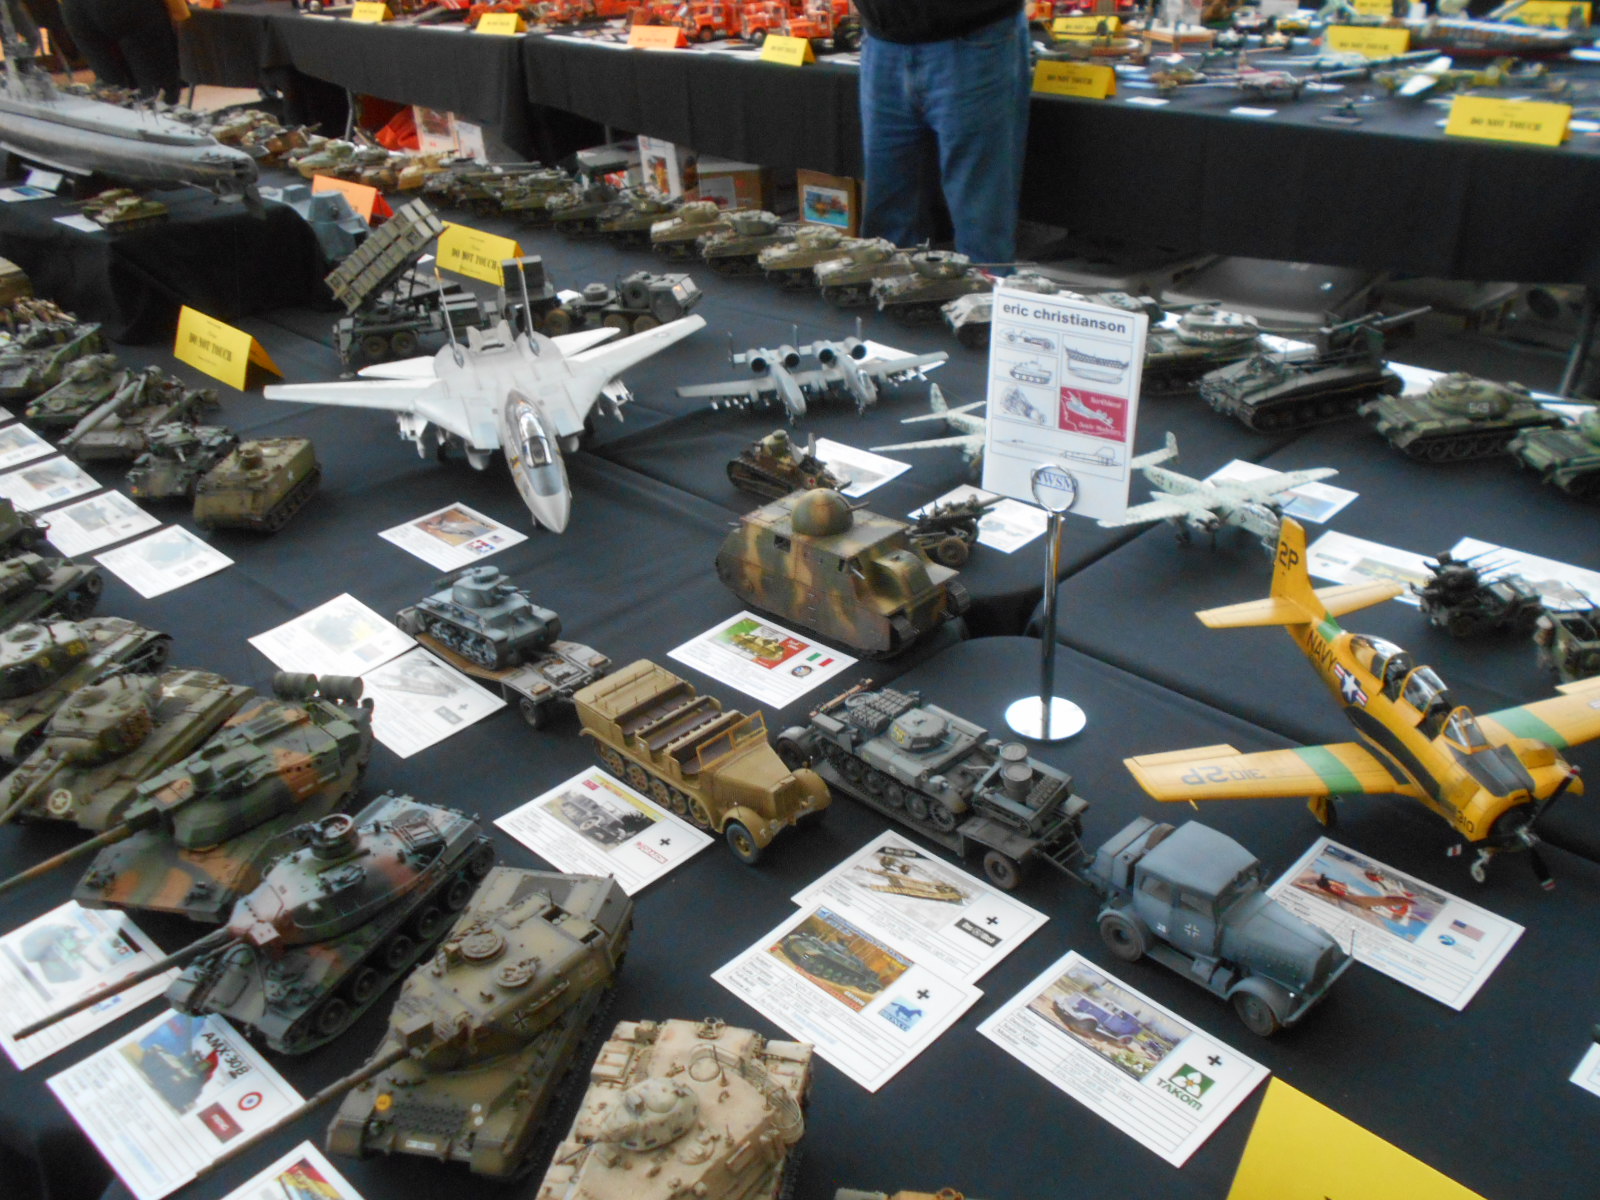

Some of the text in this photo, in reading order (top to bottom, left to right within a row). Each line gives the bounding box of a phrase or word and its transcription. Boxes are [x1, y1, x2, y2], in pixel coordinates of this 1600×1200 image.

[451, 247, 497, 270] DO NOT TOUCH
[1003, 302, 1126, 334] eric christianson
[189, 332, 198, 345] DO
[199, 336, 211, 351] NOT
[211, 342, 233, 362] TOUCH
[1305, 629, 1338, 672] NAVY
[201, 1032, 249, 1075] AMX-30B
[1157, 1077, 1203, 1111] TAKOM
